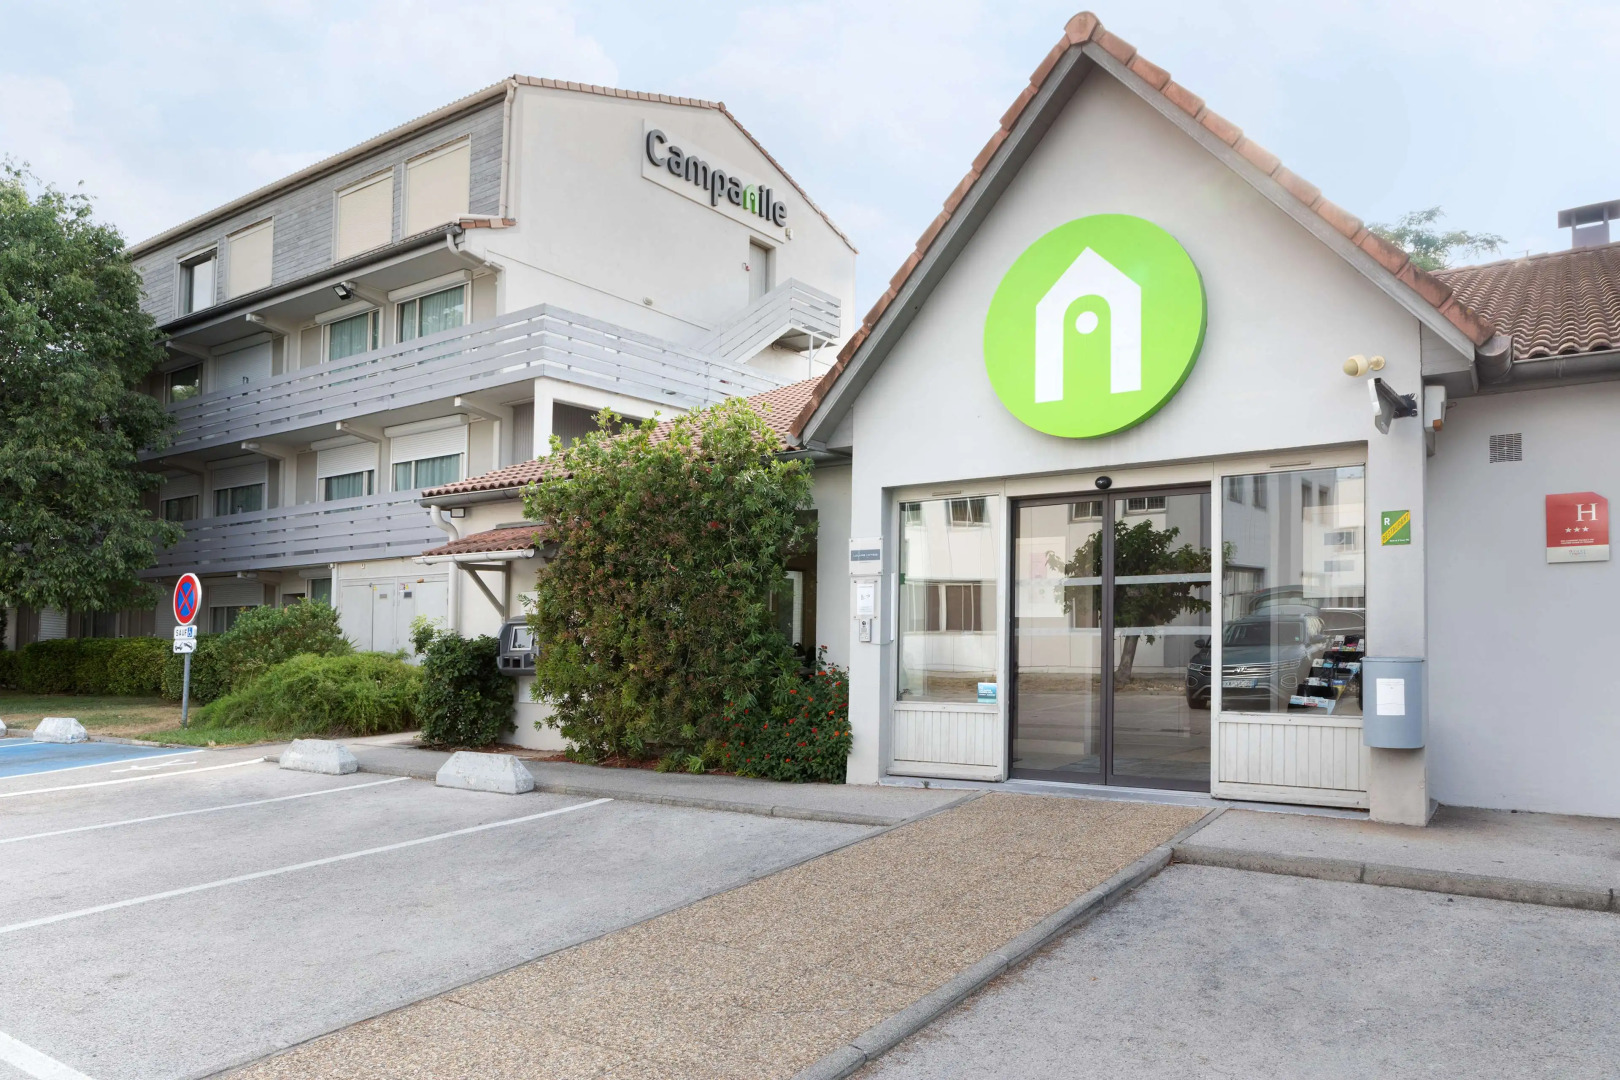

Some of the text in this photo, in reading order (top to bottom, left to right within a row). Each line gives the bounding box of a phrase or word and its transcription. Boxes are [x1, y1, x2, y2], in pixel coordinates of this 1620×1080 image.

[646, 129, 787, 227] Campanile
[1384, 517, 1390, 525] R
[1576, 503, 1598, 521] H
[1382, 514, 1409, 541] RESTAURANT
[176, 628, 187, 637] SAUF
